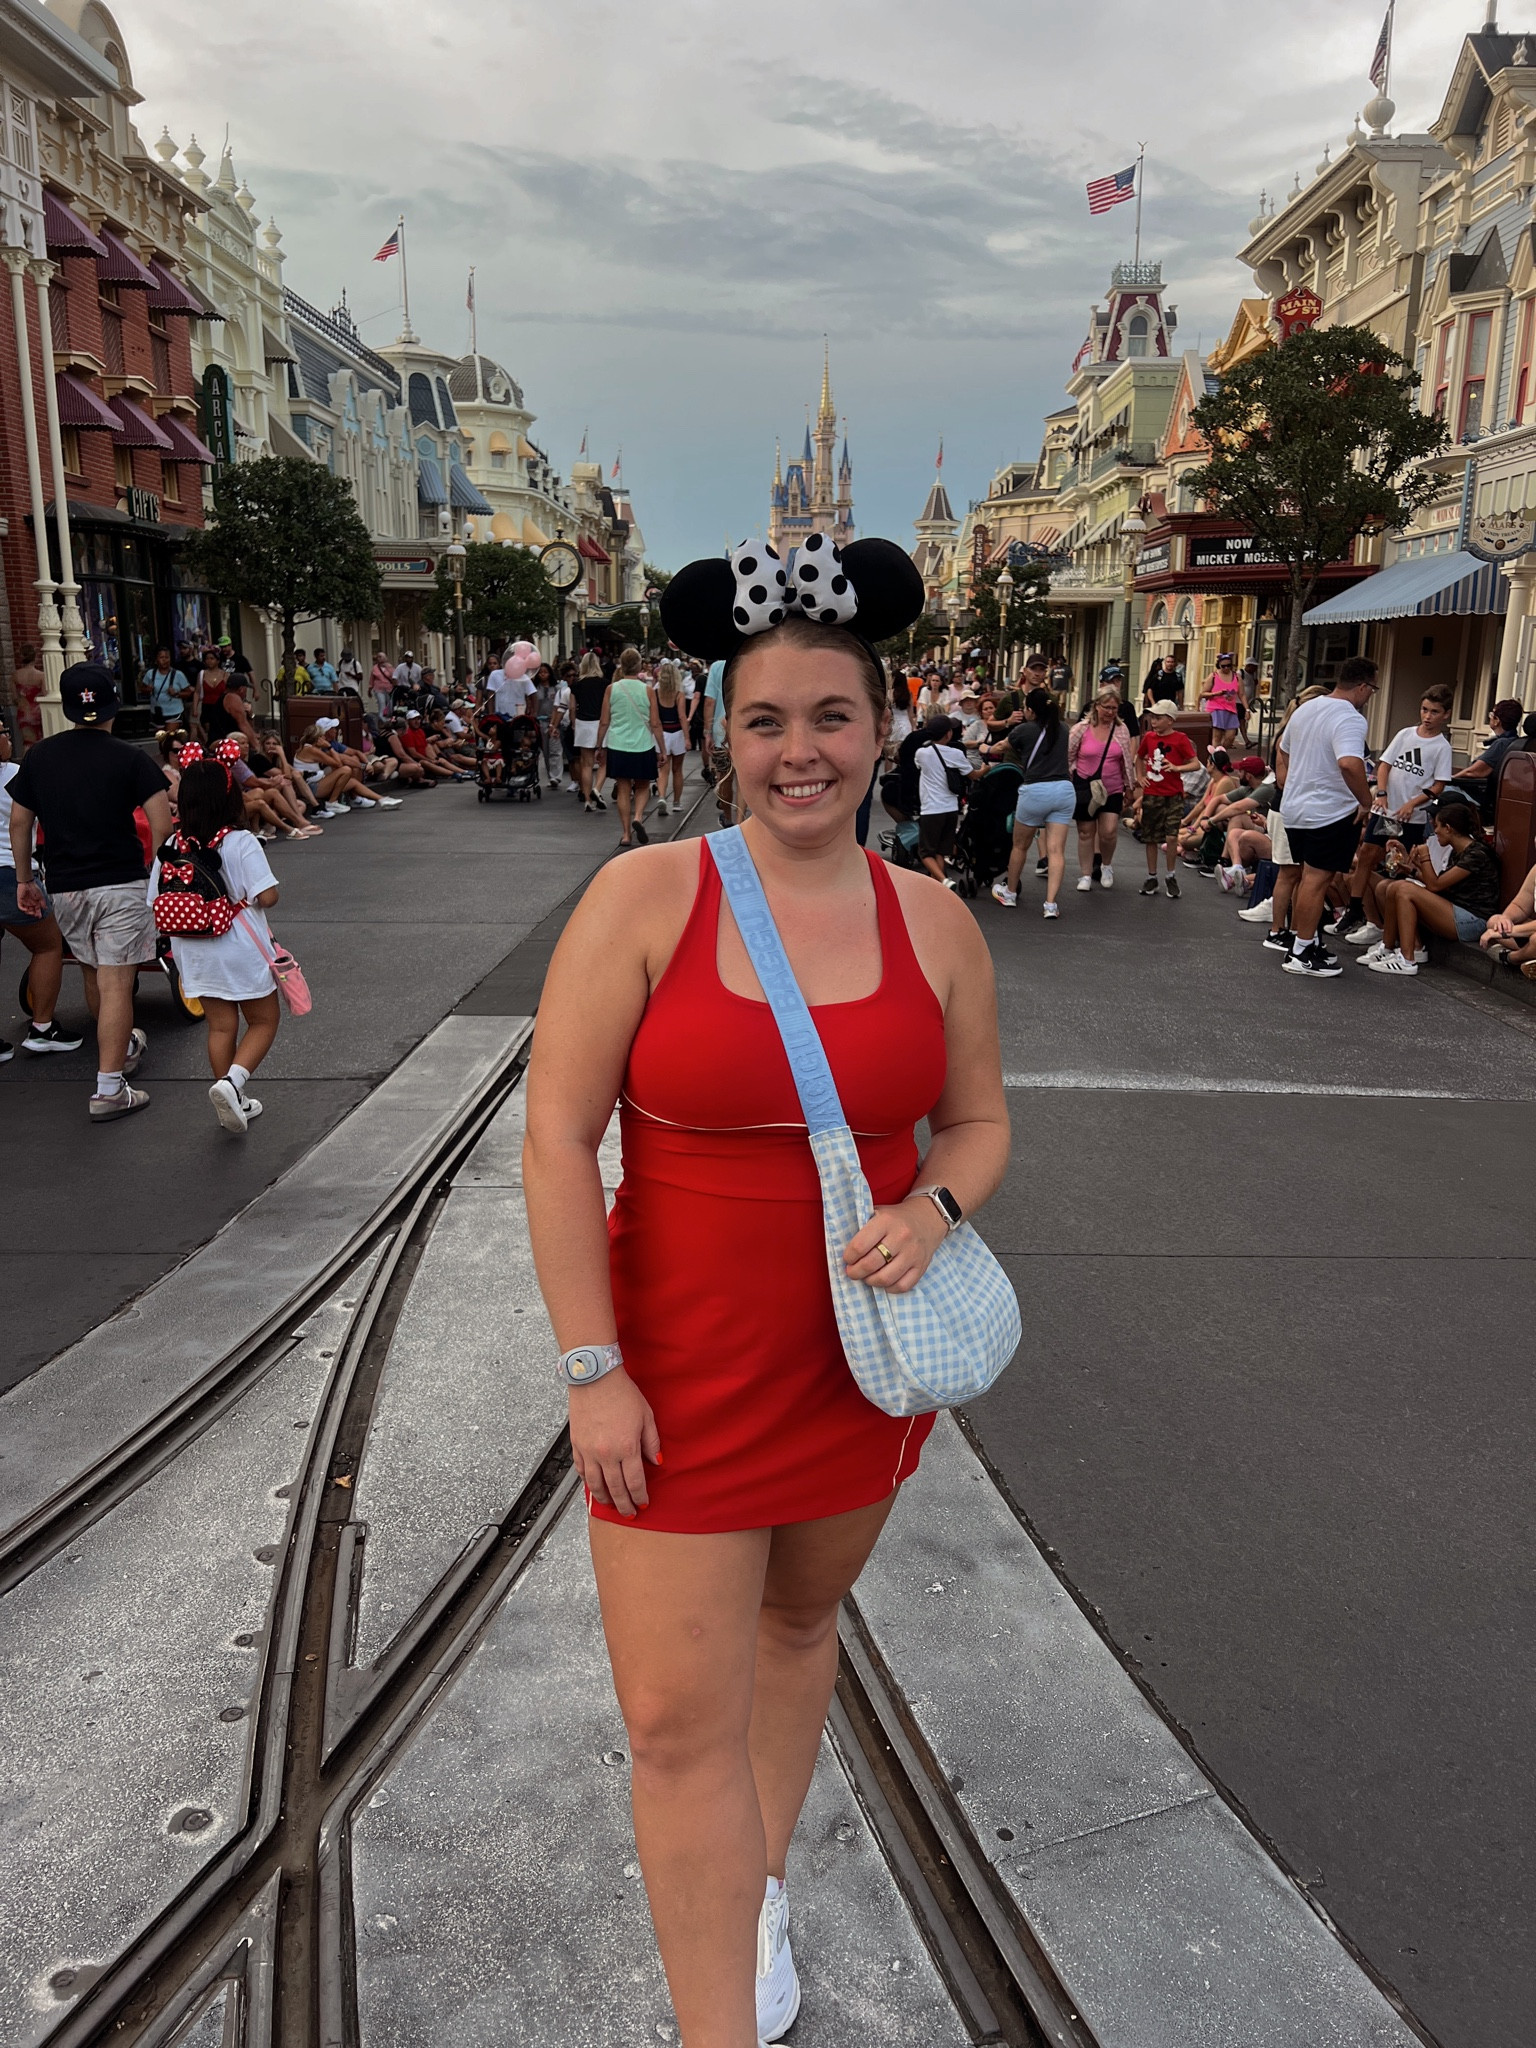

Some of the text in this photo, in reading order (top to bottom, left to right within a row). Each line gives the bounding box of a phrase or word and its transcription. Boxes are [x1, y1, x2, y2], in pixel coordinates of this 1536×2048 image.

[1280, 299, 1317, 312] MAIN
[132, 489, 160, 521] GIFTS
[1487, 520, 1517, 530] MARS
[1225, 538, 1253, 550] NOW
[1196, 554, 1238, 566] MICKEY
[1392, 760, 1425, 777] adidas
[740, 910, 804, 1014] BAGGU
